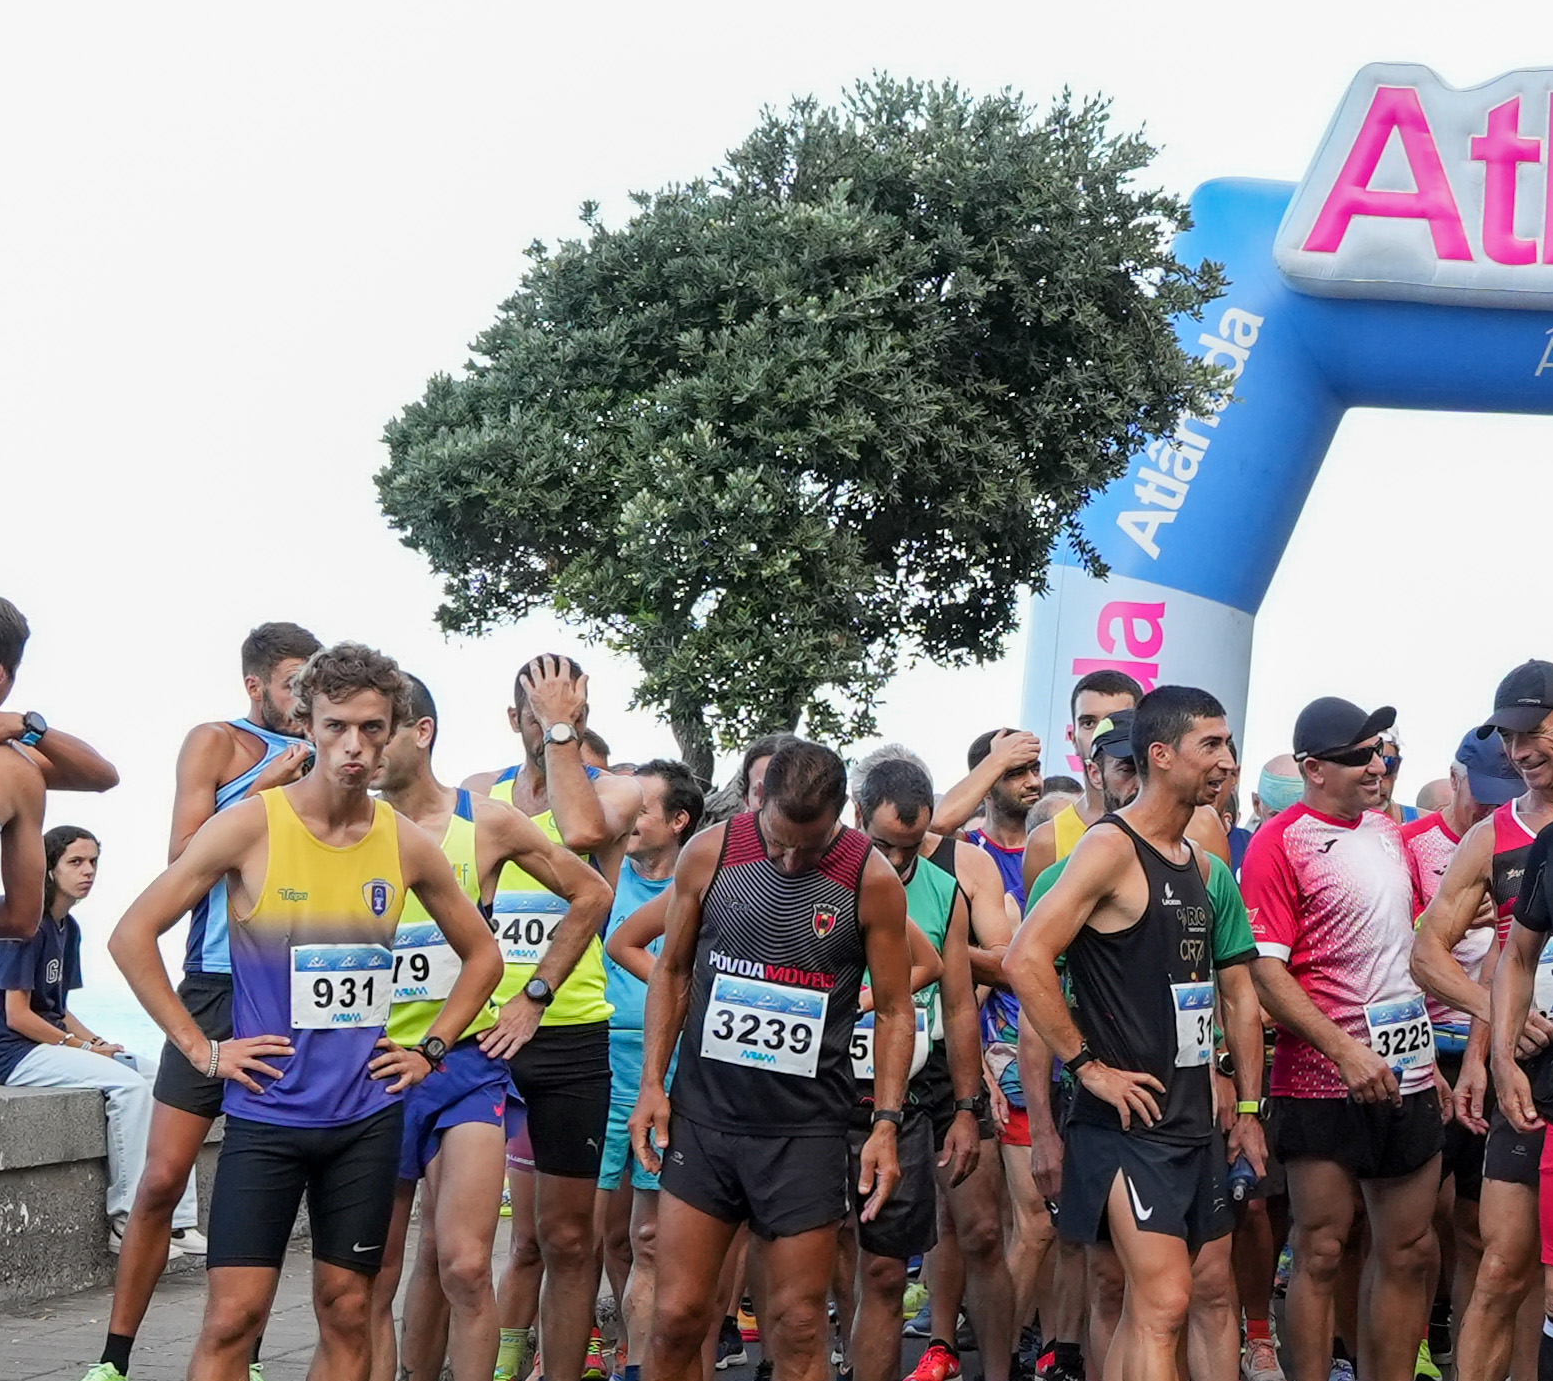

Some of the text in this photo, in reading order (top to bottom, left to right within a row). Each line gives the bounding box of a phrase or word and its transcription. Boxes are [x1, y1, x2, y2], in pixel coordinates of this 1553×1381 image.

[1115, 306, 1265, 560] Atlânda
[313, 977, 374, 1008] 931
[712, 1009, 813, 1055] 3239
[1377, 1022, 1430, 1057] 3225
